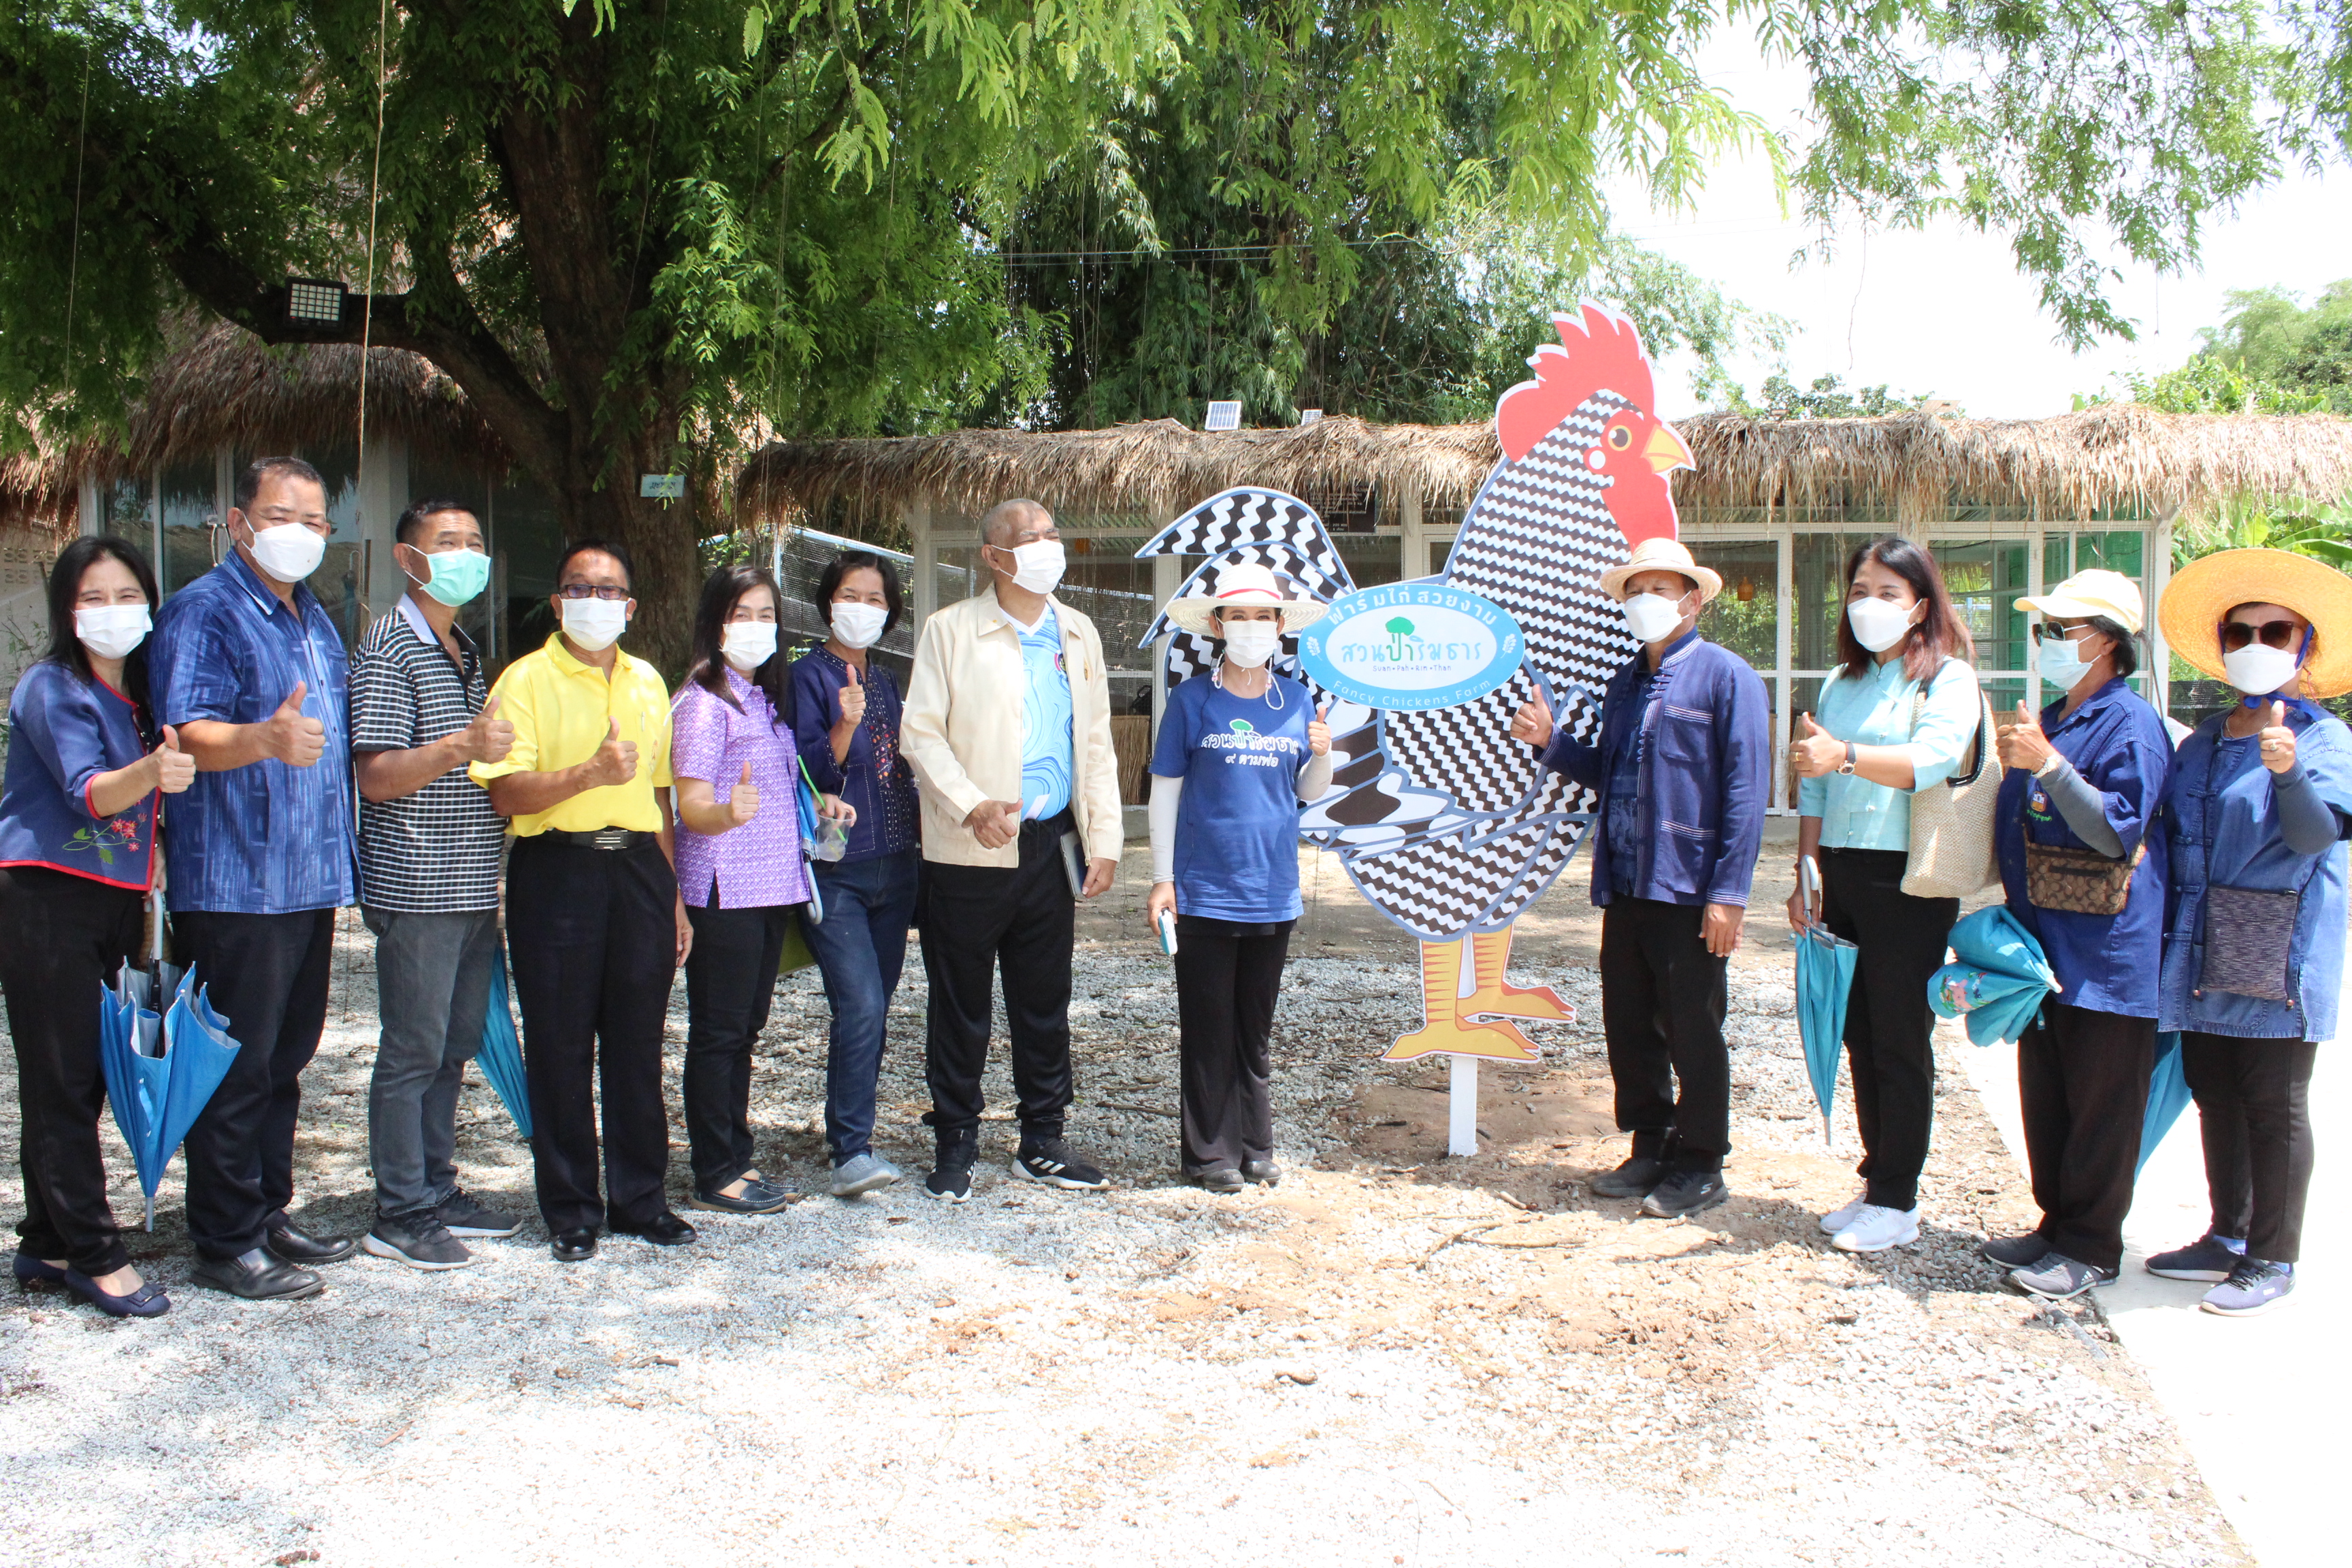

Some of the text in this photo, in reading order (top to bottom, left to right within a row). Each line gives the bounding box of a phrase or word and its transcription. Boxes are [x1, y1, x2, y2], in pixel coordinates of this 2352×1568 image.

[1341, 634, 1481, 663] สวนป่าริมธาร
[1333, 680, 1490, 706] Fancy Chickens Farm
[1239, 753, 1279, 767] ตามพ่อ
